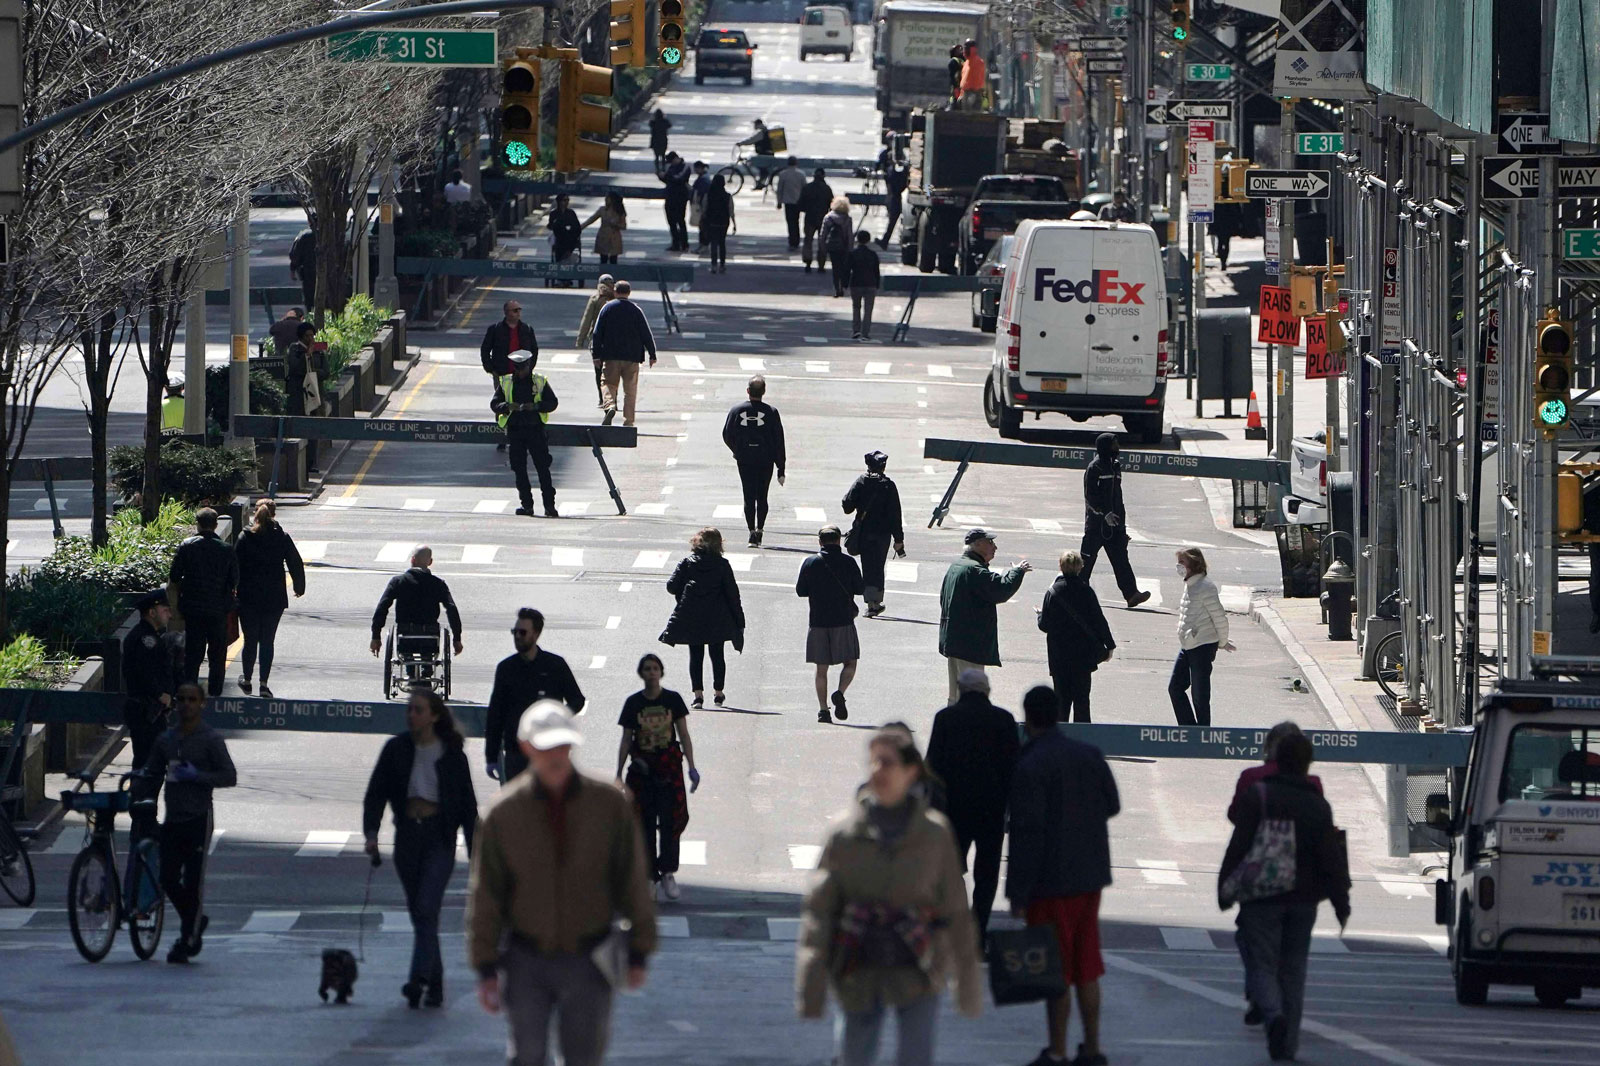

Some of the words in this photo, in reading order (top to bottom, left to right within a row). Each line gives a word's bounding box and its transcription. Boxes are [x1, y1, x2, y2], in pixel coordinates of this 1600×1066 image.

[377, 37, 388, 58] E
[398, 37, 416, 58] 31
[425, 37, 445, 58] St
[1189, 66, 1196, 78] E
[1201, 66, 1216, 78] 30
[1175, 106, 1195, 115] ONE
[1203, 107, 1223, 115] WAY
[1511, 127, 1533, 143] ONE
[1304, 136, 1312, 152] E
[1319, 136, 1333, 152] 31
[1253, 179, 1277, 189] ONE
[1292, 179, 1318, 190] WAY
[1508, 170, 1539, 186] ONE
[1560, 169, 1597, 185] WAY
[1569, 233, 1581, 255] E
[1592, 233, 1600, 256] 3
[492, 261, 516, 270] POLICE
[1034, 268, 1146, 305] FedEx
[1386, 283, 1393, 296] 3
[1263, 291, 1291, 312] RAIS
[1098, 305, 1140, 316] Express
[1261, 318, 1298, 341] PLOW
[1308, 324, 1326, 345] RA
[1096, 355, 1143, 365] fedex.com
[1308, 351, 1345, 374] PLOW
[1382, 354, 1399, 364] 1070
[364, 422, 395, 431] POLICE
[400, 423, 419, 432] LINE
[436, 424, 449, 432] DO
[455, 424, 473, 433] NOT
[1052, 450, 1085, 460] POLICE
[1129, 454, 1141, 464] DO
[1144, 455, 1163, 465] NOT
[1167, 457, 1198, 467] CROSS
[214, 700, 245, 714] LINE
[269, 702, 286, 715] DO
[293, 703, 320, 716] NOT
[326, 704, 372, 718] CROSS
[1557, 697, 1600, 708] POLIC
[238, 716, 286, 726] NYPD
[1140, 728, 1188, 743] POLICE
[1201, 730, 1231, 744] LINE
[1312, 732, 1358, 747] CROSS
[1224, 747, 1266, 756] NYP
[1547, 862, 1600, 873] NY
[1532, 875, 1600, 888] POL
[1571, 906, 1600, 920] 261
[1003, 946, 1049, 975] sg
